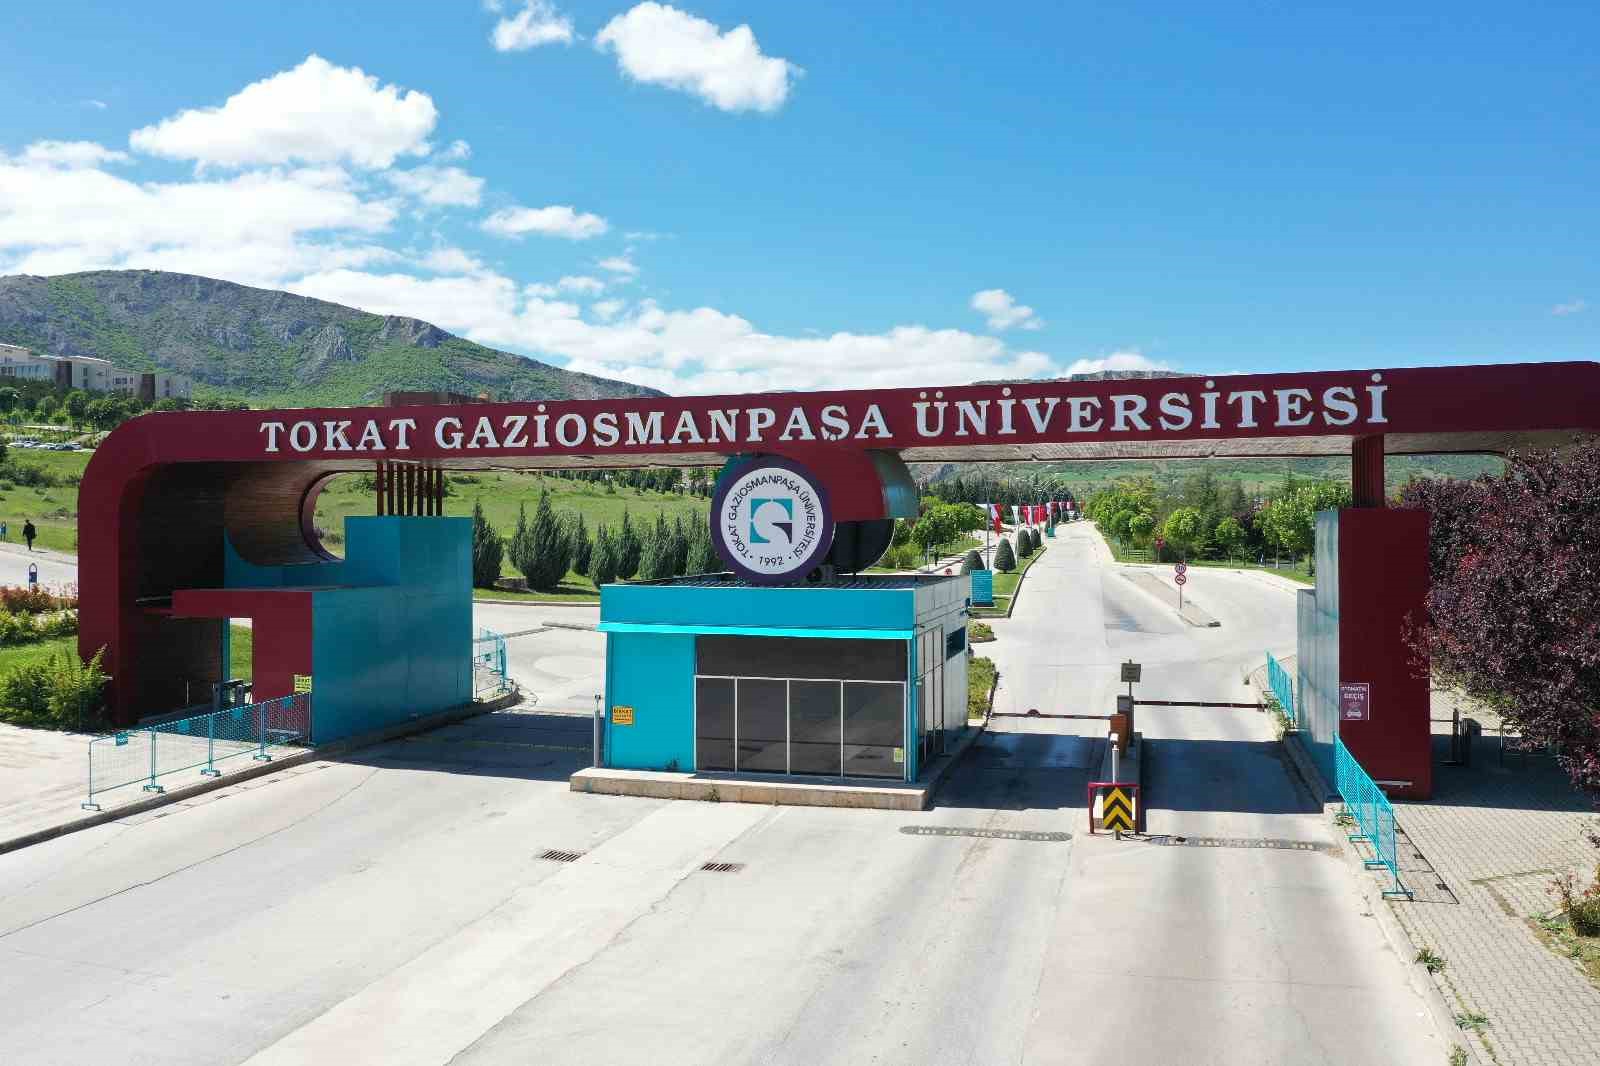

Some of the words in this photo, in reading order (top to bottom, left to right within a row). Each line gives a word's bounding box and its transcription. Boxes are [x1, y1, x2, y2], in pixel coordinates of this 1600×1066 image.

[259, 418, 417, 452] TOKAT
[912, 373, 1389, 437] ÜNİVERSİTESİ
[729, 525, 749, 559] TOKAT
[759, 556, 785, 566] 1992
